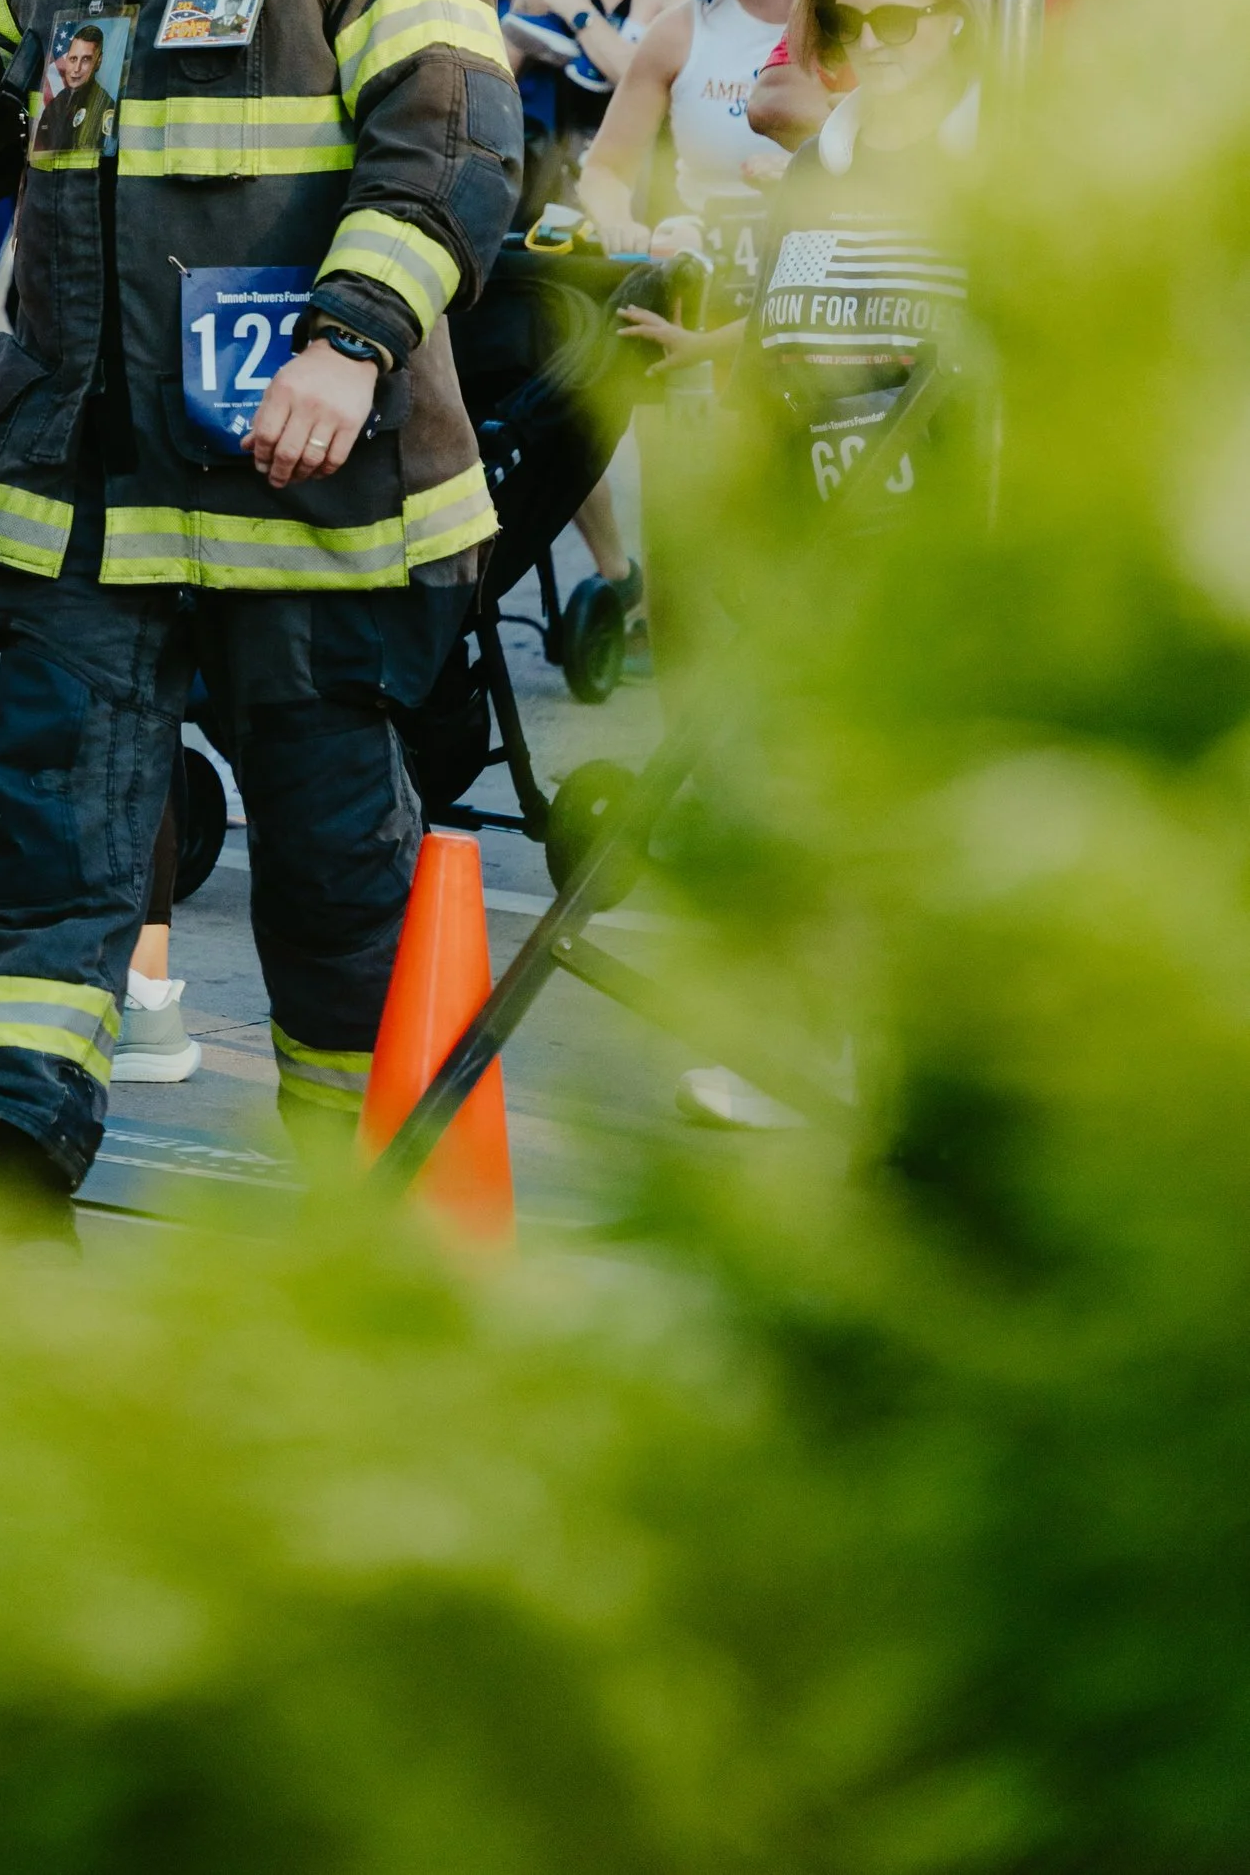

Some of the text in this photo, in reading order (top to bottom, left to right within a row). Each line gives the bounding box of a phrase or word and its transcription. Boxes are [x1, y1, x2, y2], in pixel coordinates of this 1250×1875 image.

[216, 291, 247, 304] Tunnel
[251, 291, 285, 303] Towers
[767, 294, 804, 328] RUN
[810, 295, 858, 326] FOR
[190, 312, 301, 391] 12
